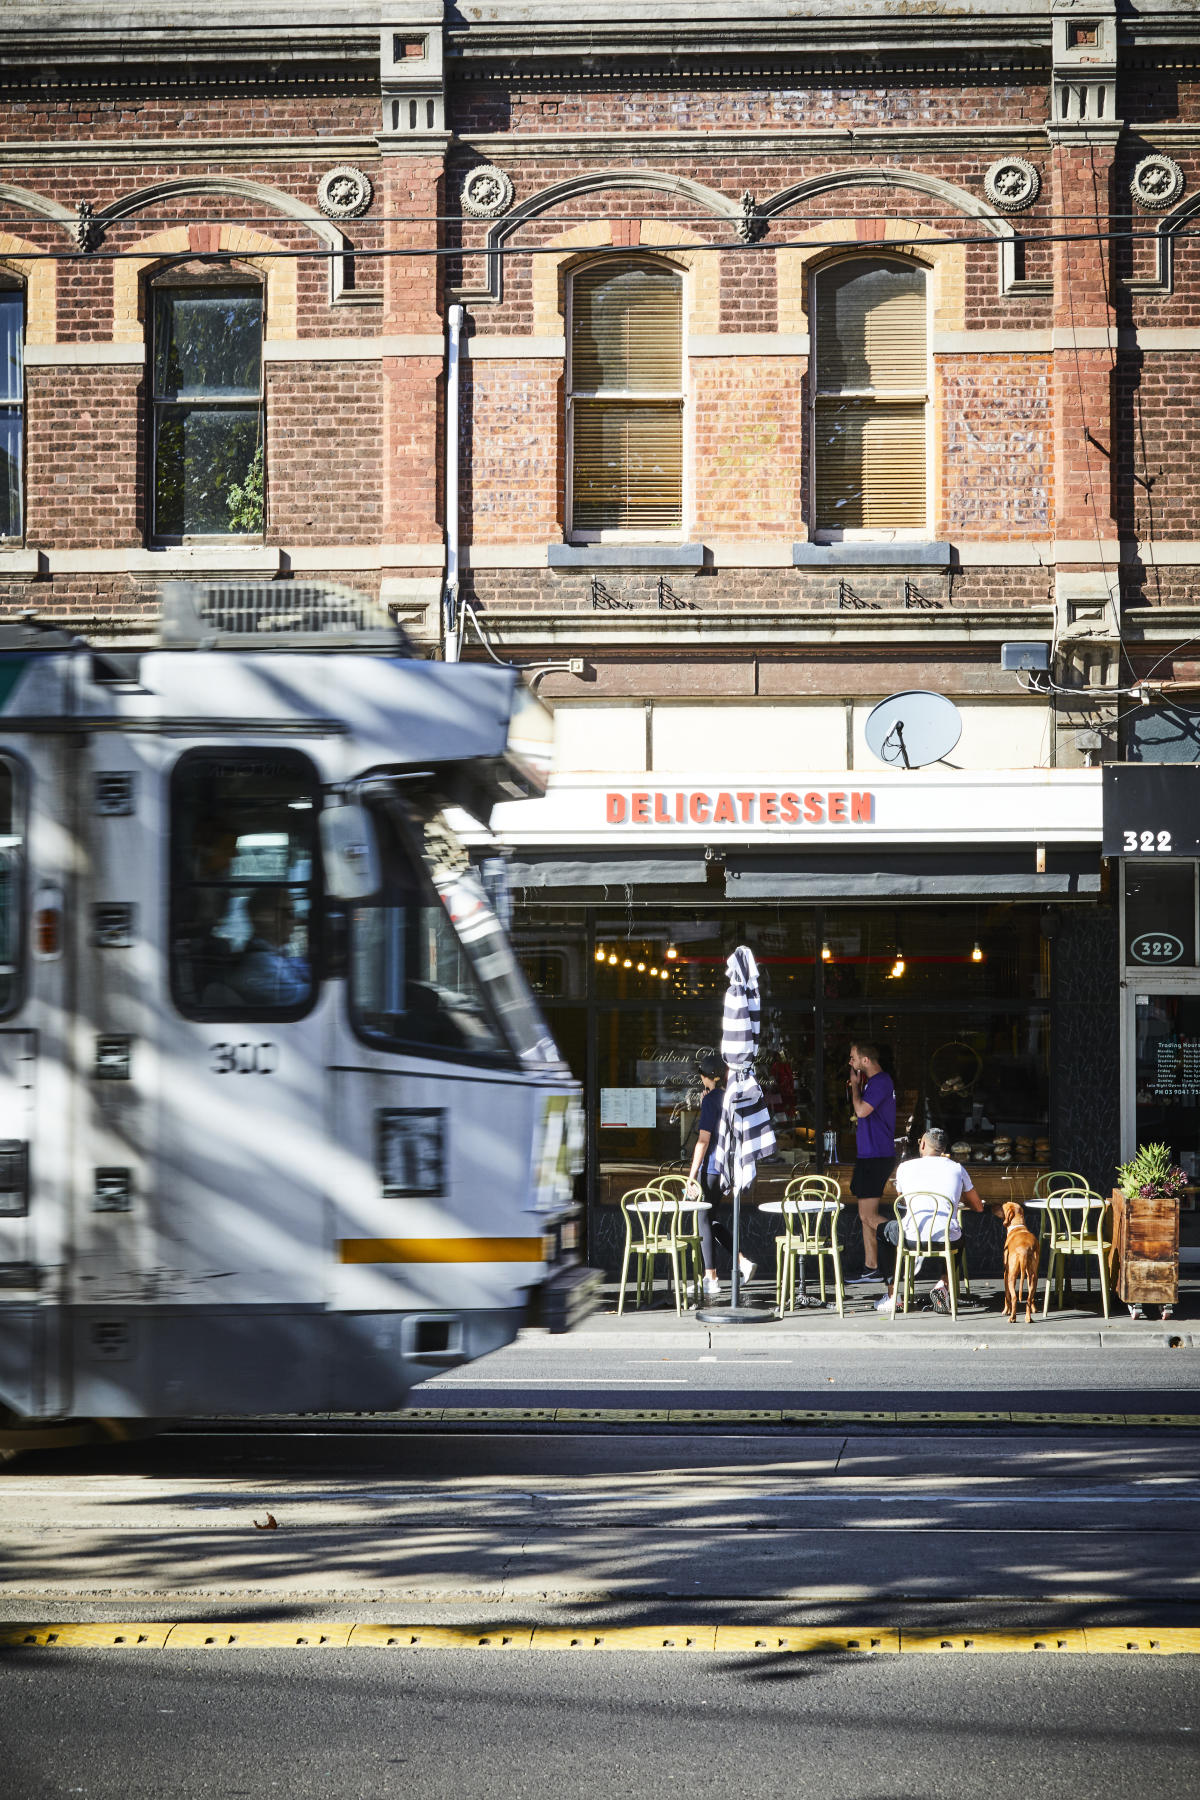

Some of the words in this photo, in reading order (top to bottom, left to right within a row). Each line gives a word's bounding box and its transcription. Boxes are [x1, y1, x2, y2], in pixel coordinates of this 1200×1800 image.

[606, 792, 874, 824] DELICATESSEN
[1123, 830, 1172, 852] 322
[1141, 942, 1173, 956] 322
